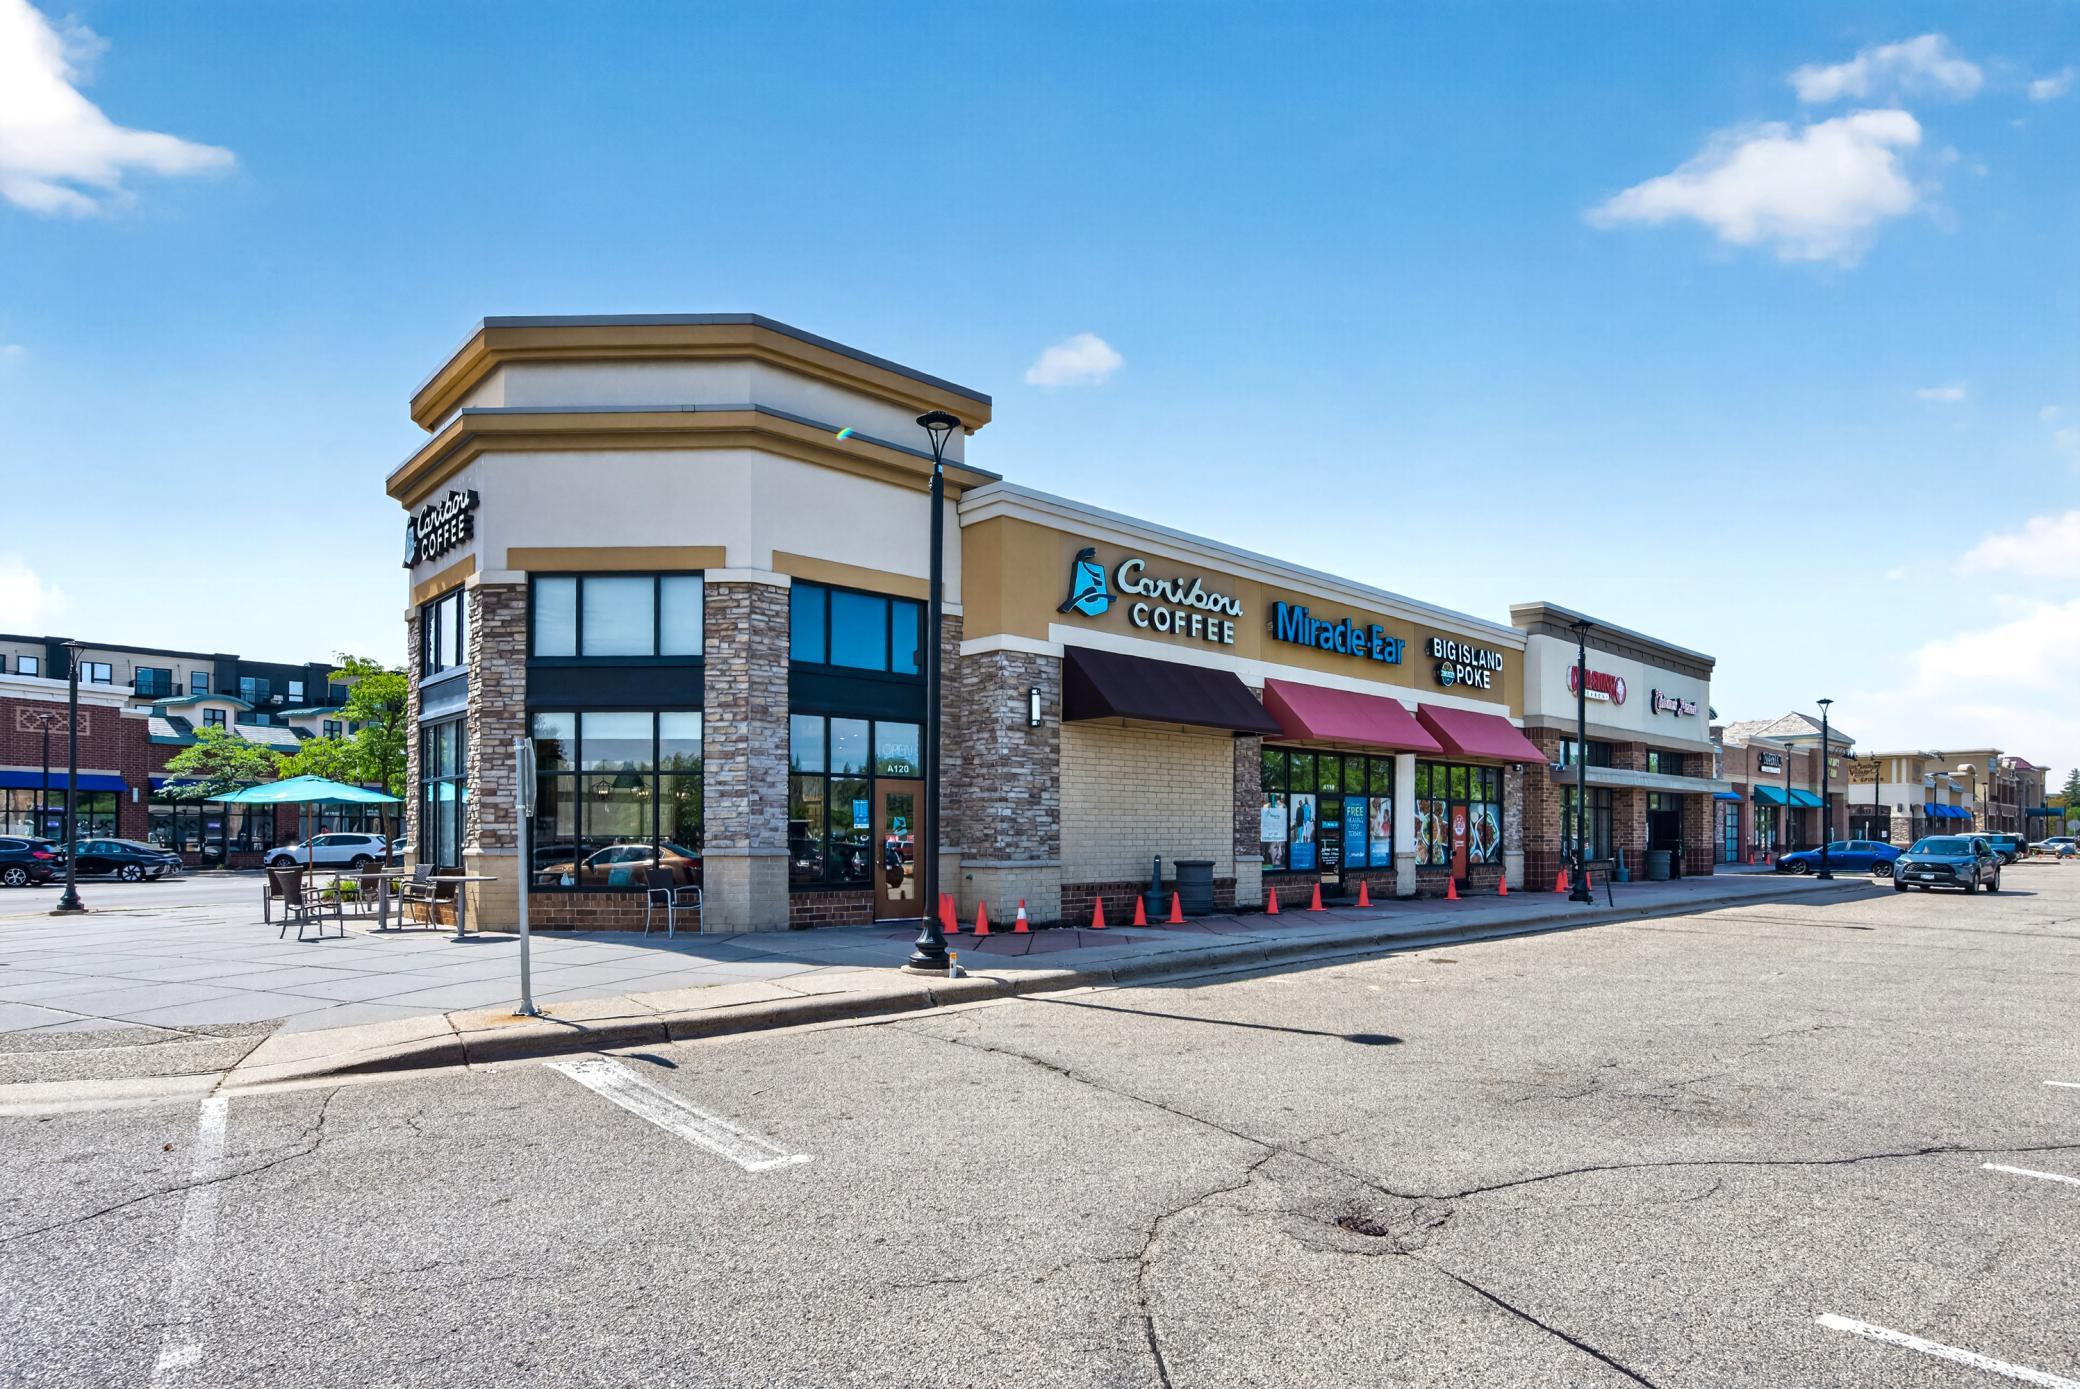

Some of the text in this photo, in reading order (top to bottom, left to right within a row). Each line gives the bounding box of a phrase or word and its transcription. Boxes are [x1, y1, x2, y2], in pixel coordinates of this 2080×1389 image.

[417, 489, 470, 539] Caribou
[421, 513, 465, 561] COFFEE
[1115, 558, 1244, 617] Caribou
[1130, 602, 1235, 645] COFFEE
[1433, 637, 1503, 672] BIG ISLAND
[1456, 664, 1491, 689] POKE
[882, 743, 913, 758] OPEN
[888, 765, 909, 774] A120
[1346, 806, 1364, 817] FREE
